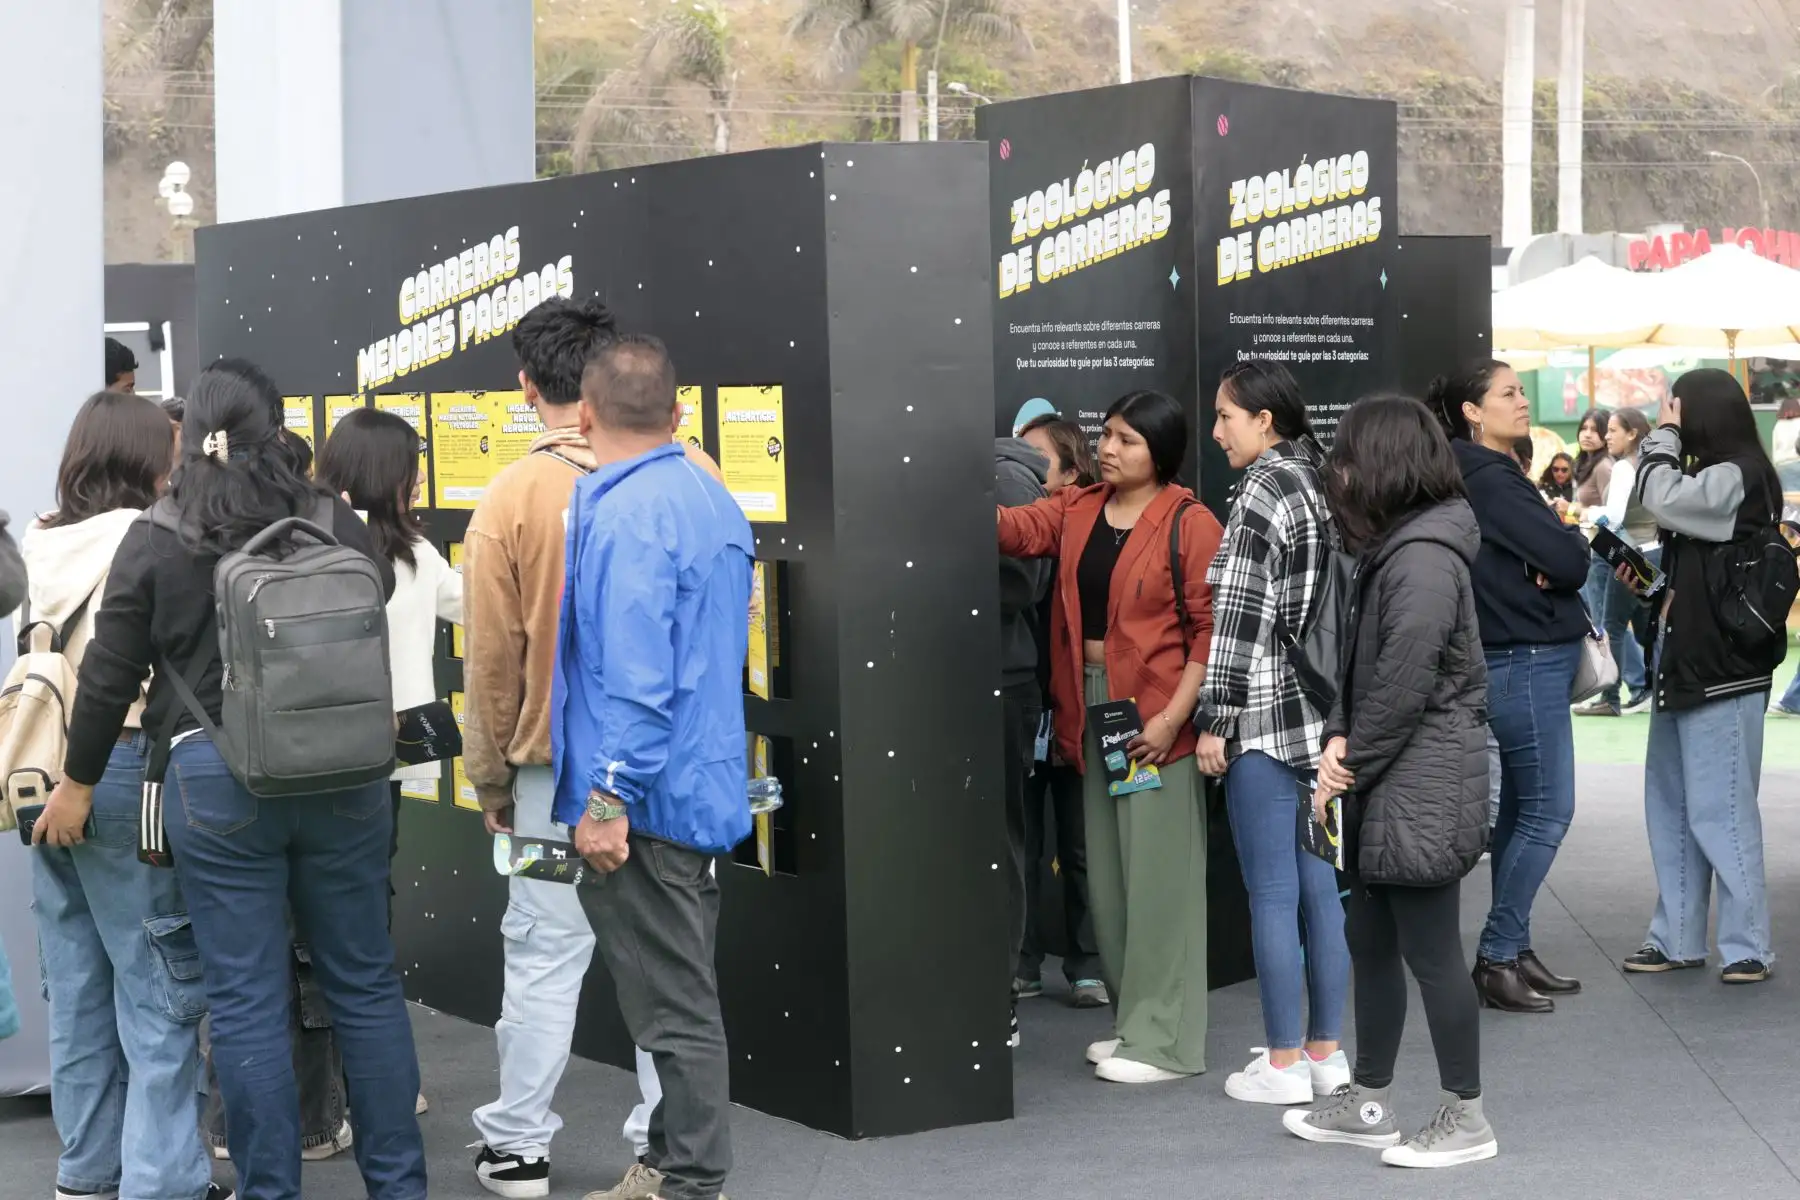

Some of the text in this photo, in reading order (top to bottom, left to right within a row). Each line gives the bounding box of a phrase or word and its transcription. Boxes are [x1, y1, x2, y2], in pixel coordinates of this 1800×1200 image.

[1011, 143, 1156, 244] ZOOLÓGICO
[1230, 150, 1369, 228] ZOOLÓGICO
[1000, 189, 1172, 299] DE CARRERAS
[1217, 196, 1382, 286] DE CARRERAS
[1628, 227, 1712, 271] PAPA
[399, 226, 521, 325] CARRERAS
[357, 255, 573, 393] MEJORES PAGADAS
[1010, 320, 1160, 334] Encuentra info relevante sobre diferentes carreras
[1230, 313, 1374, 326] Encuentra info relevante sobre diferentes carreras
[1253, 332, 1354, 344] y conoce a referentes en cada una.
[1016, 357, 1028, 370] Que
[1029, 359, 1036, 368] tu
[1037, 357, 1069, 368] curiosidad
[1070, 358, 1077, 368] te
[1092, 358, 1102, 369] por
[1103, 357, 1112, 367] las
[1113, 357, 1118, 367] 3
[1032, 339, 1137, 352] y conoce a referentes en cada una.
[1237, 350, 1250, 362] Que
[1259, 350, 1289, 361] curiosidad
[1291, 351, 1297, 361] te
[1312, 353, 1322, 363] por
[1323, 351, 1332, 361] las
[1332, 351, 1336, 361] 3
